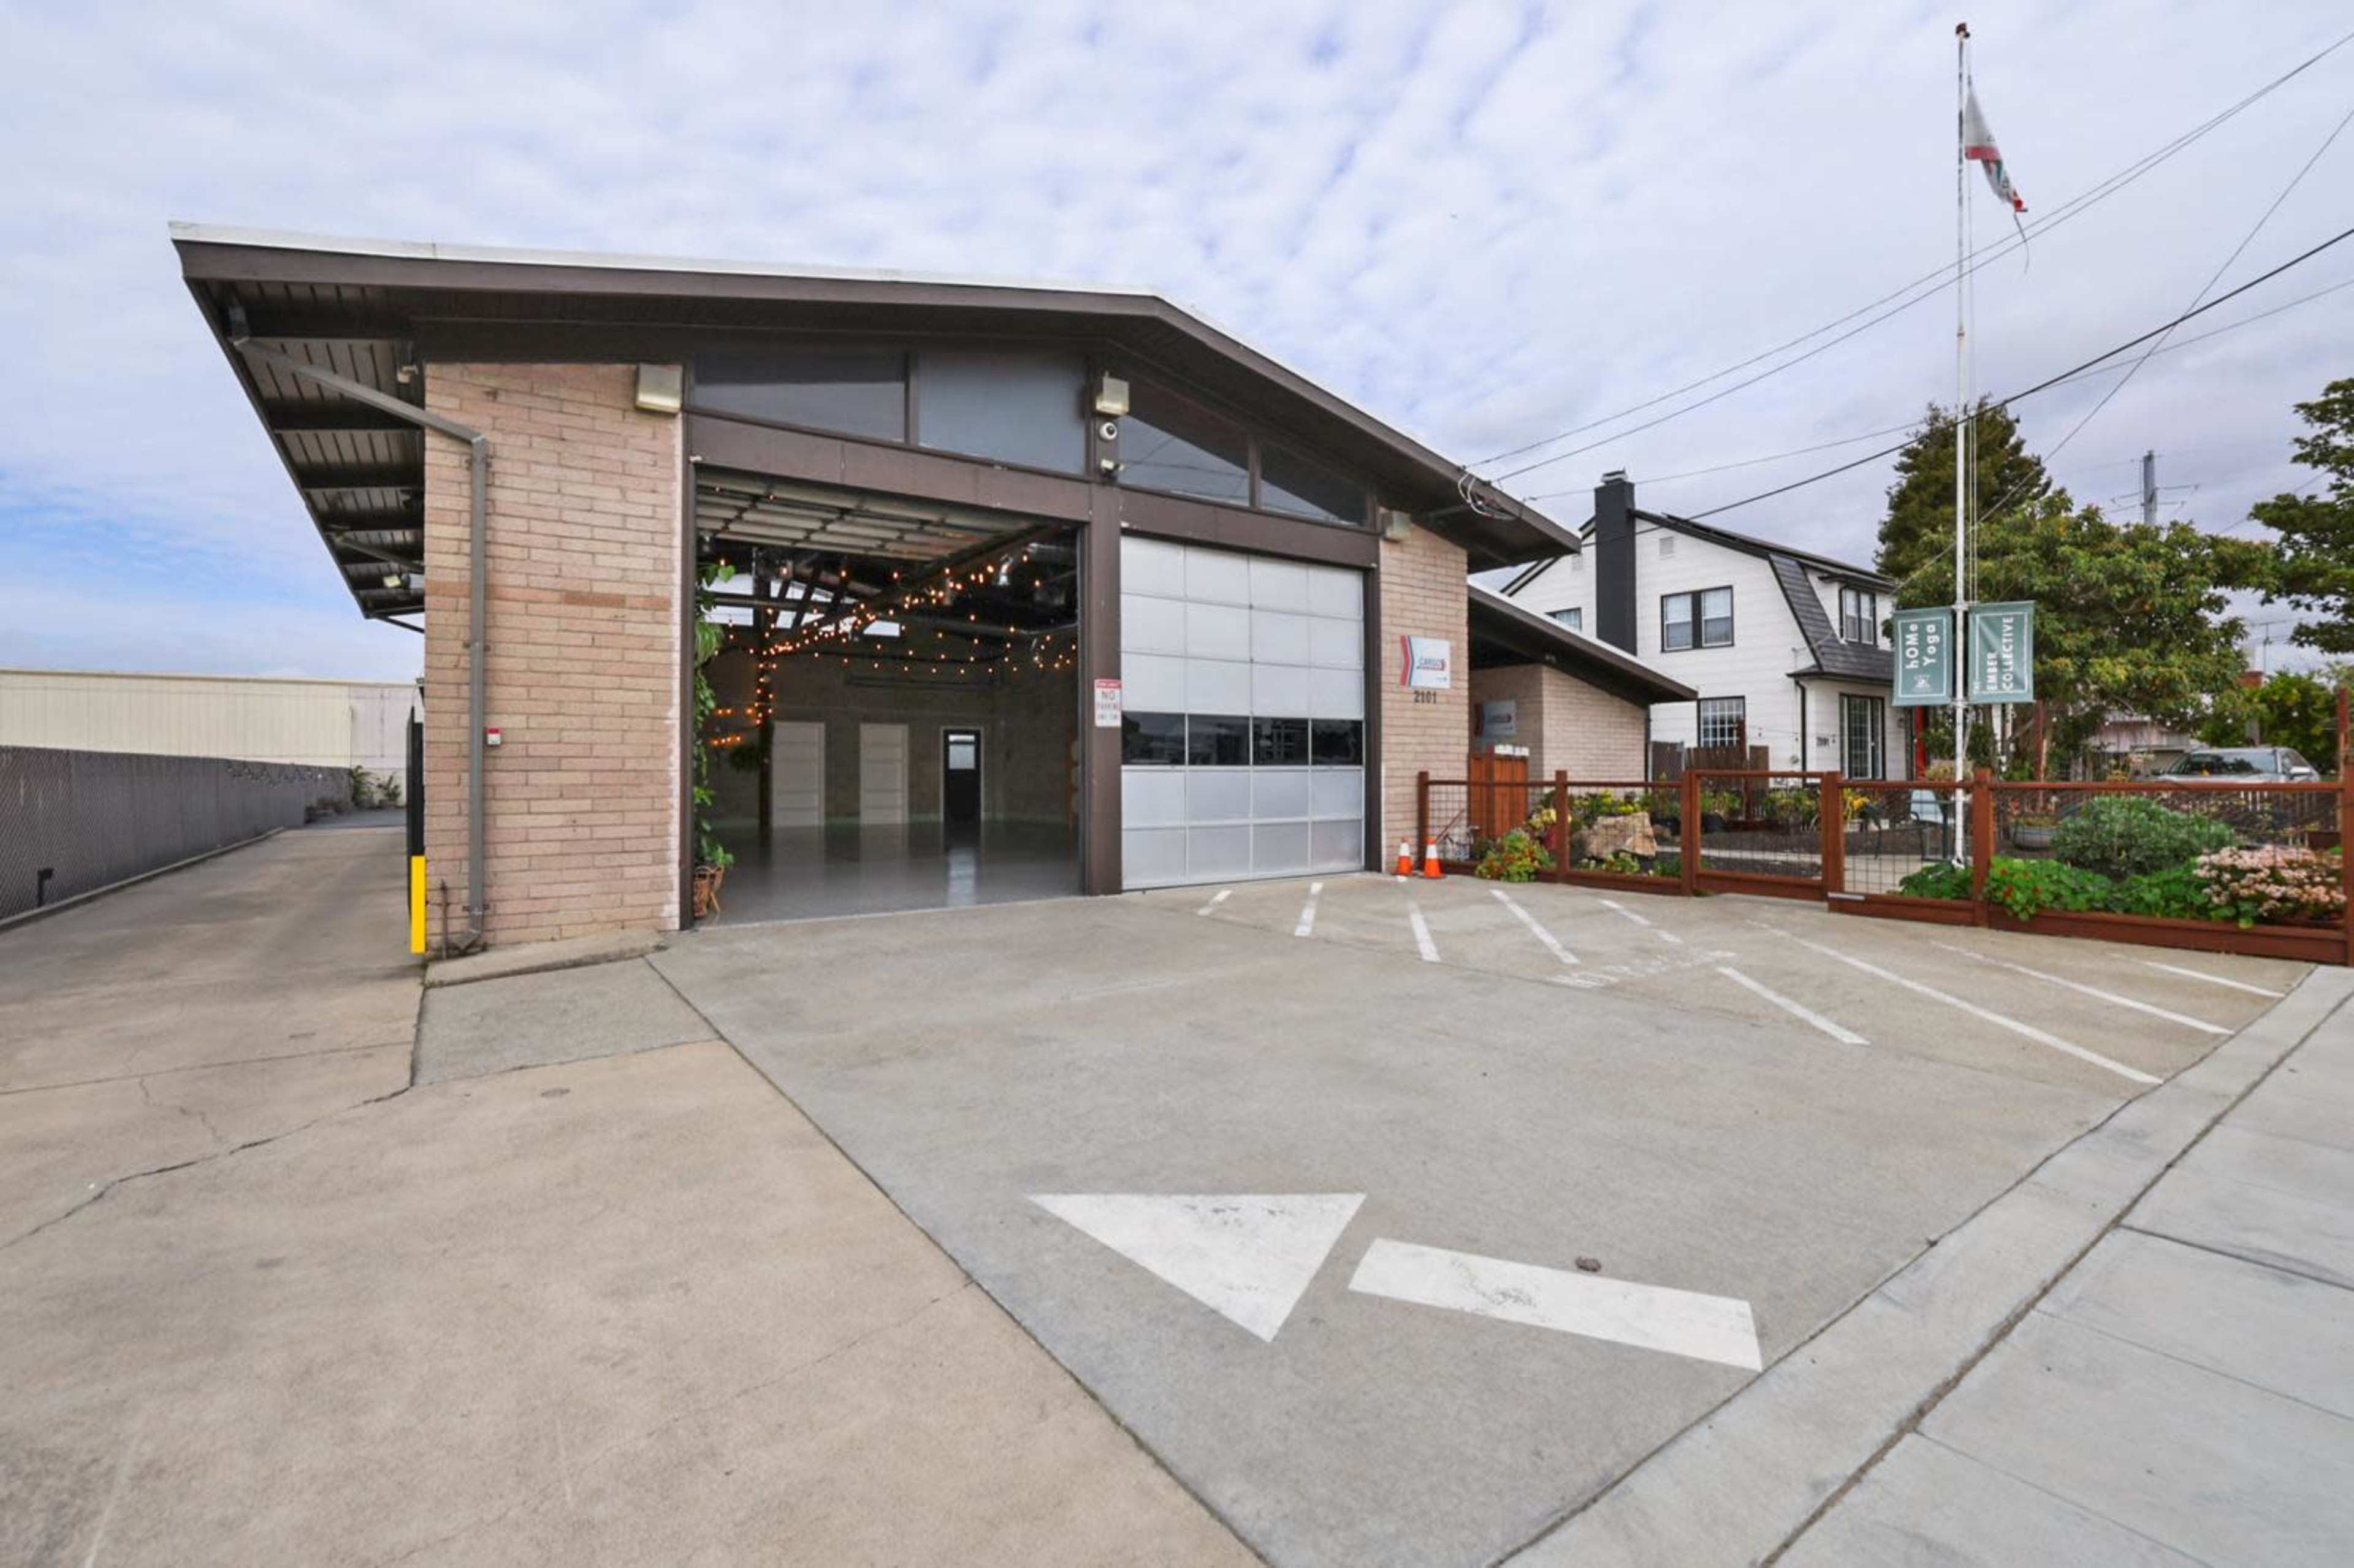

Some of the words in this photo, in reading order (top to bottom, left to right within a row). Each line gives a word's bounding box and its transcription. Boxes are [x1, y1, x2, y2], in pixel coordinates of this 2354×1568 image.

[1922, 624, 1940, 666] Yoga
[2002, 614, 2014, 690] COLLECTIVE
[1987, 652, 1997, 690] EMBER
[1413, 690, 1437, 704] 2101
